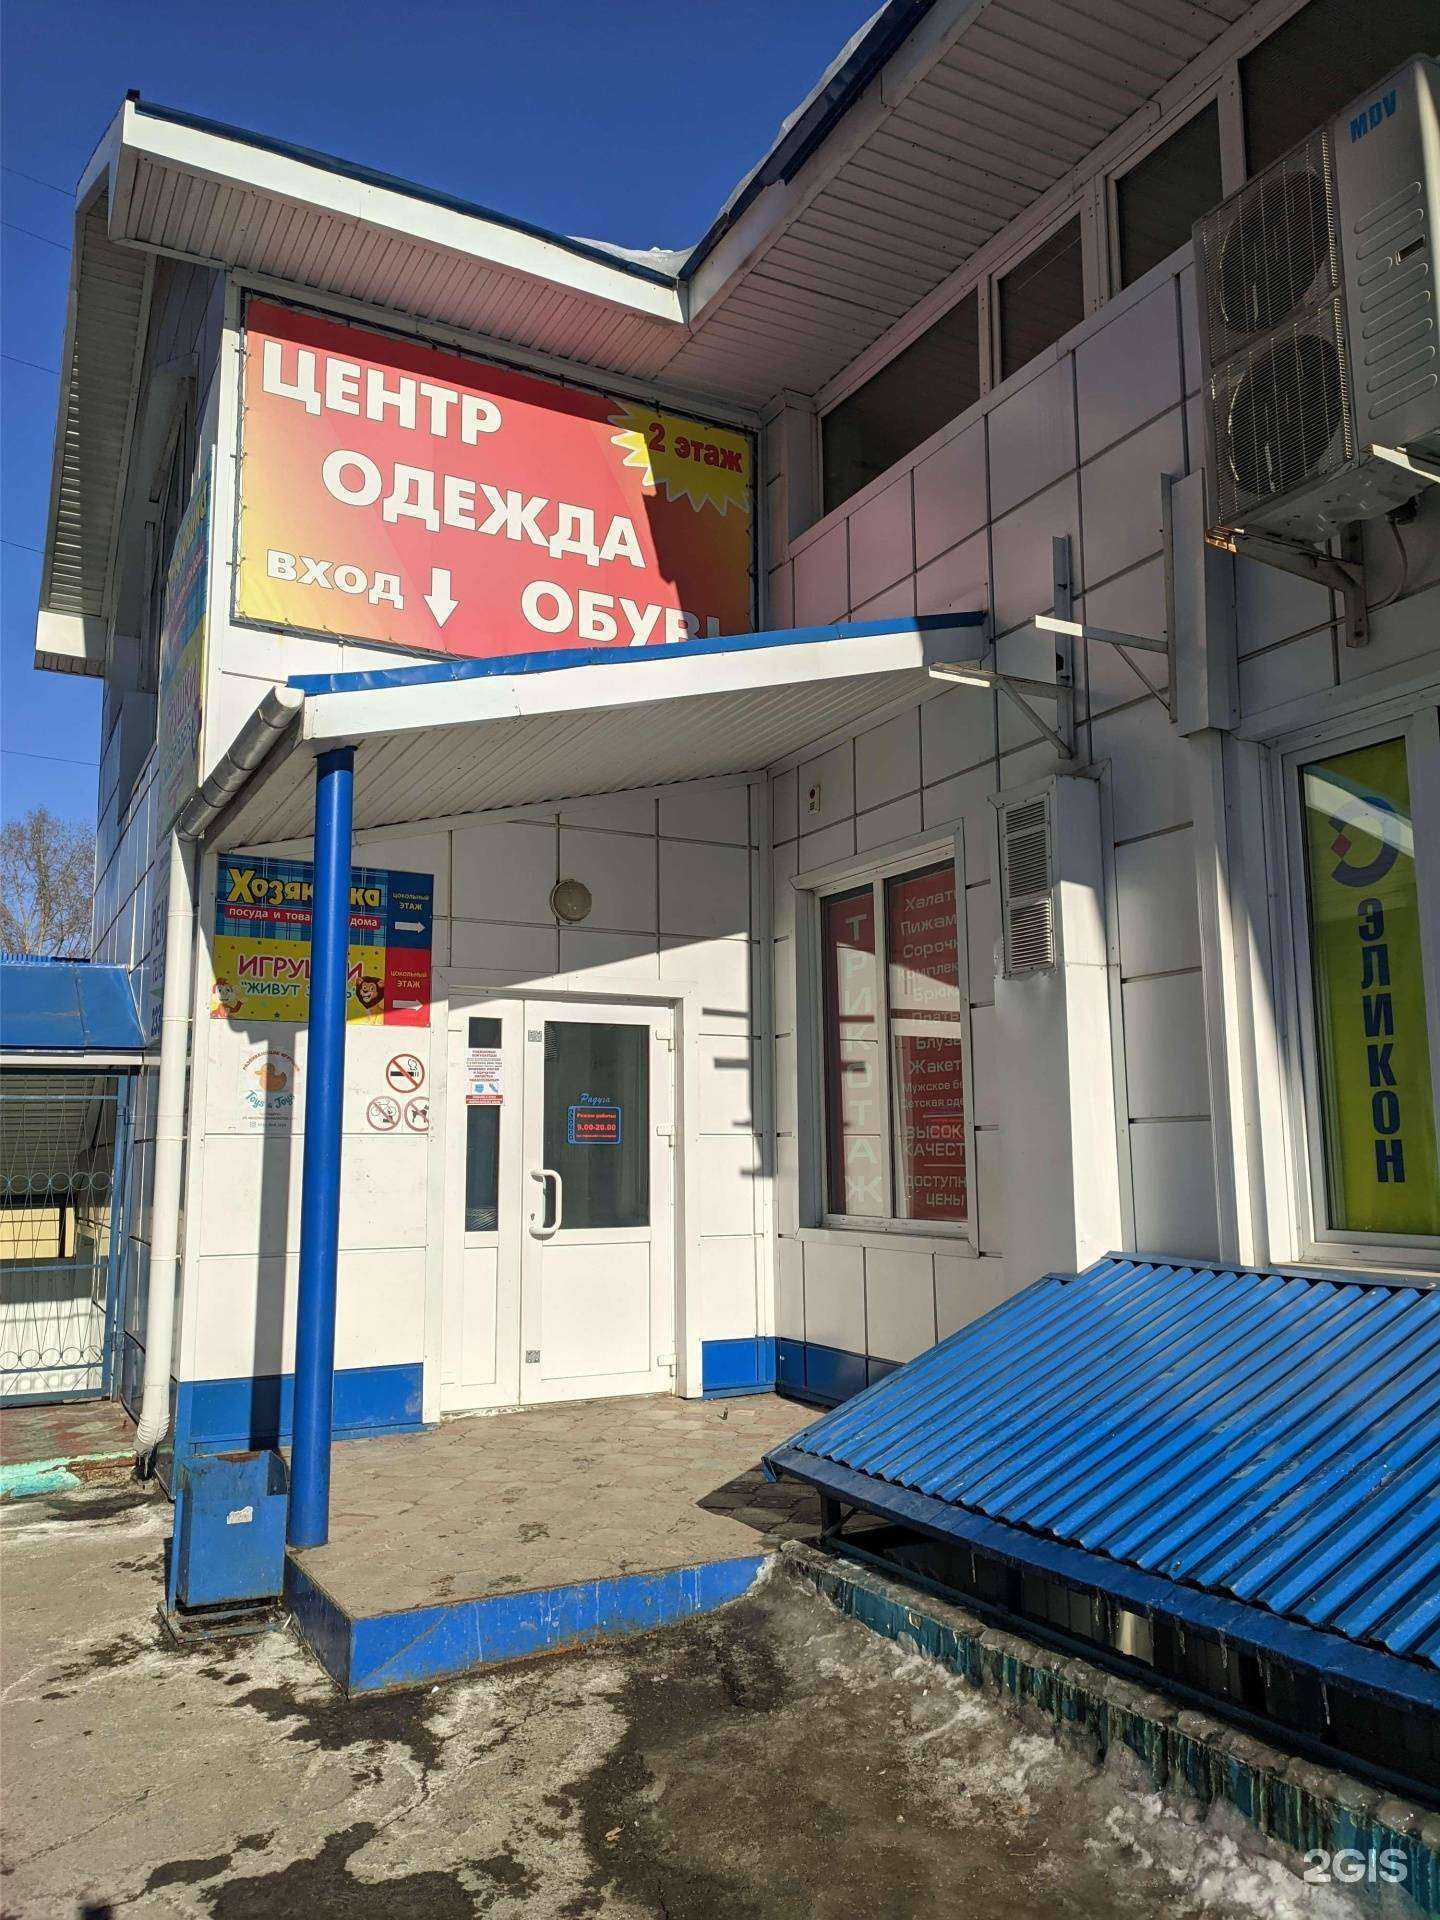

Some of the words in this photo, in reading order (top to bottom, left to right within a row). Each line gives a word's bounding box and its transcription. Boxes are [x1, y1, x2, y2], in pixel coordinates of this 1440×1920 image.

[1350, 89, 1396, 143] MDV
[262, 340, 501, 446] ЦЕНТР
[648, 422, 666, 453] 2
[674, 436, 743, 473] этаж
[321, 449, 647, 568] ОДЕЖДА
[399, 902, 423, 911] ЭТАЖ
[904, 889, 956, 911] Халат
[229, 907, 268, 919] посуда
[350, 917, 378, 927] дома
[396, 980, 421, 989] ЭТАЖ
[1356, 897, 1405, 1183] ЭЛИКОН
[906, 1124, 965, 1139] ВЫСОК
[926, 1192, 964, 1207] ЦЕНЫ
